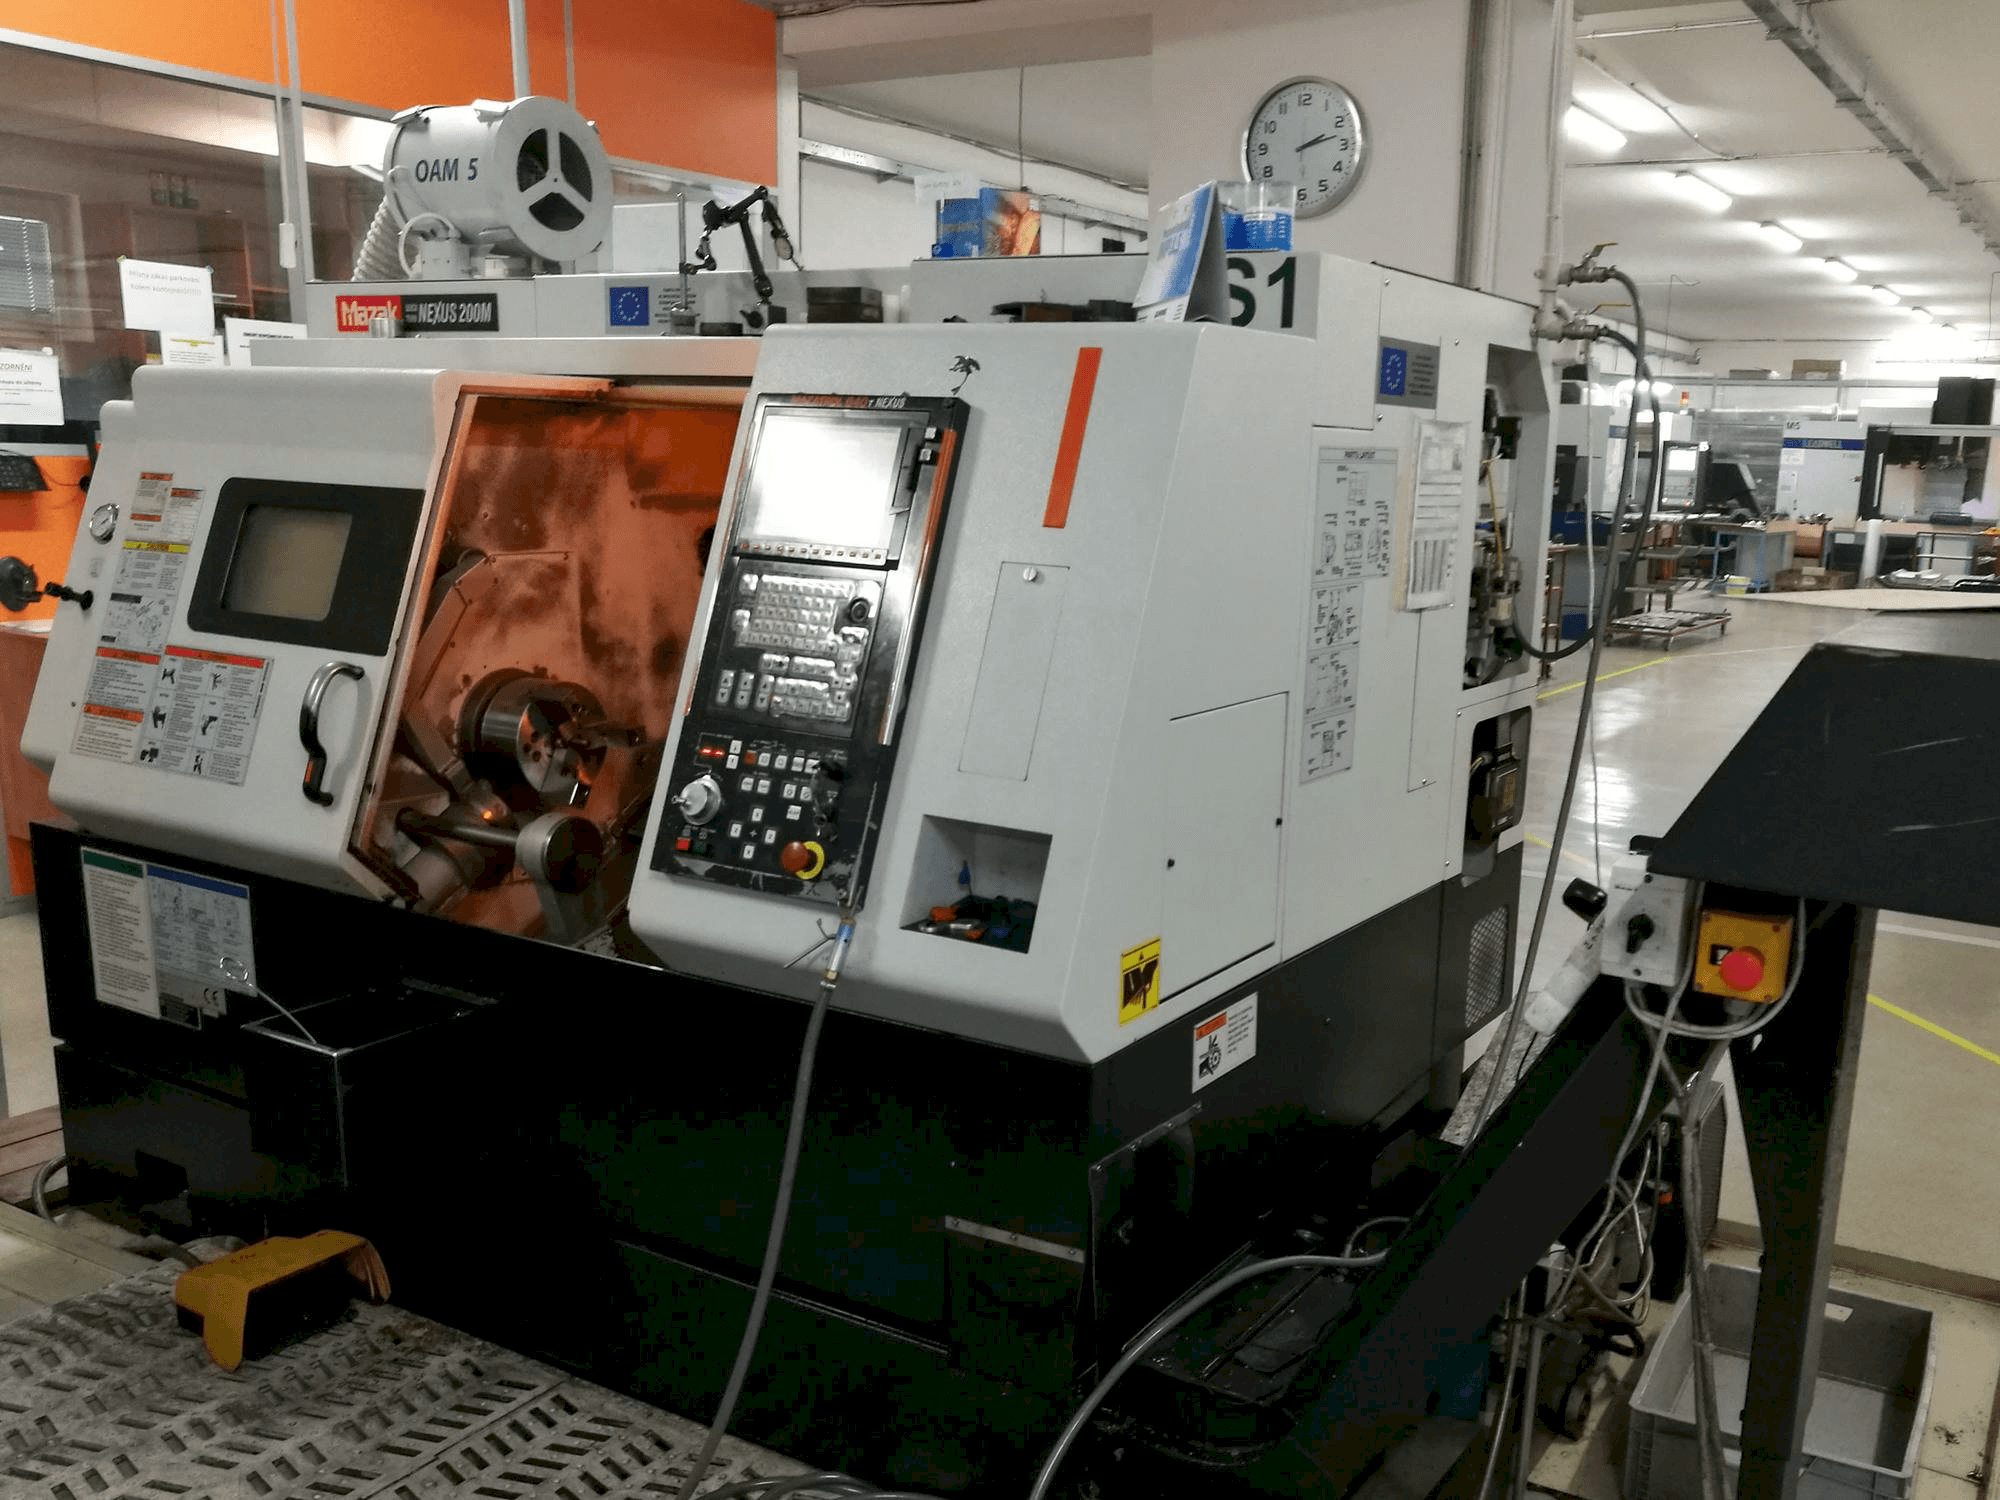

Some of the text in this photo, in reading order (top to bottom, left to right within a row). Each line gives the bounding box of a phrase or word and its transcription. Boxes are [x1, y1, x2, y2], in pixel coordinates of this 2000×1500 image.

[1298, 93, 1312, 106] 12
[1279, 102, 1287, 115] 11
[1263, 120, 1277, 134] 10
[1334, 115, 1345, 129] 2
[1257, 143, 1268, 156] 9
[1339, 138, 1349, 151] 3
[415, 157, 478, 183] OAM 5
[1263, 165, 1273, 178] 8
[1332, 160, 1343, 173] 4
[1318, 179, 1329, 192] 5
[1296, 188, 1307, 201] 6
[341, 299, 398, 327] Mazak
[418, 301, 457, 325] NEXUS
[459, 301, 492, 324] 200M
[875, 395, 906, 409] NEXUS
